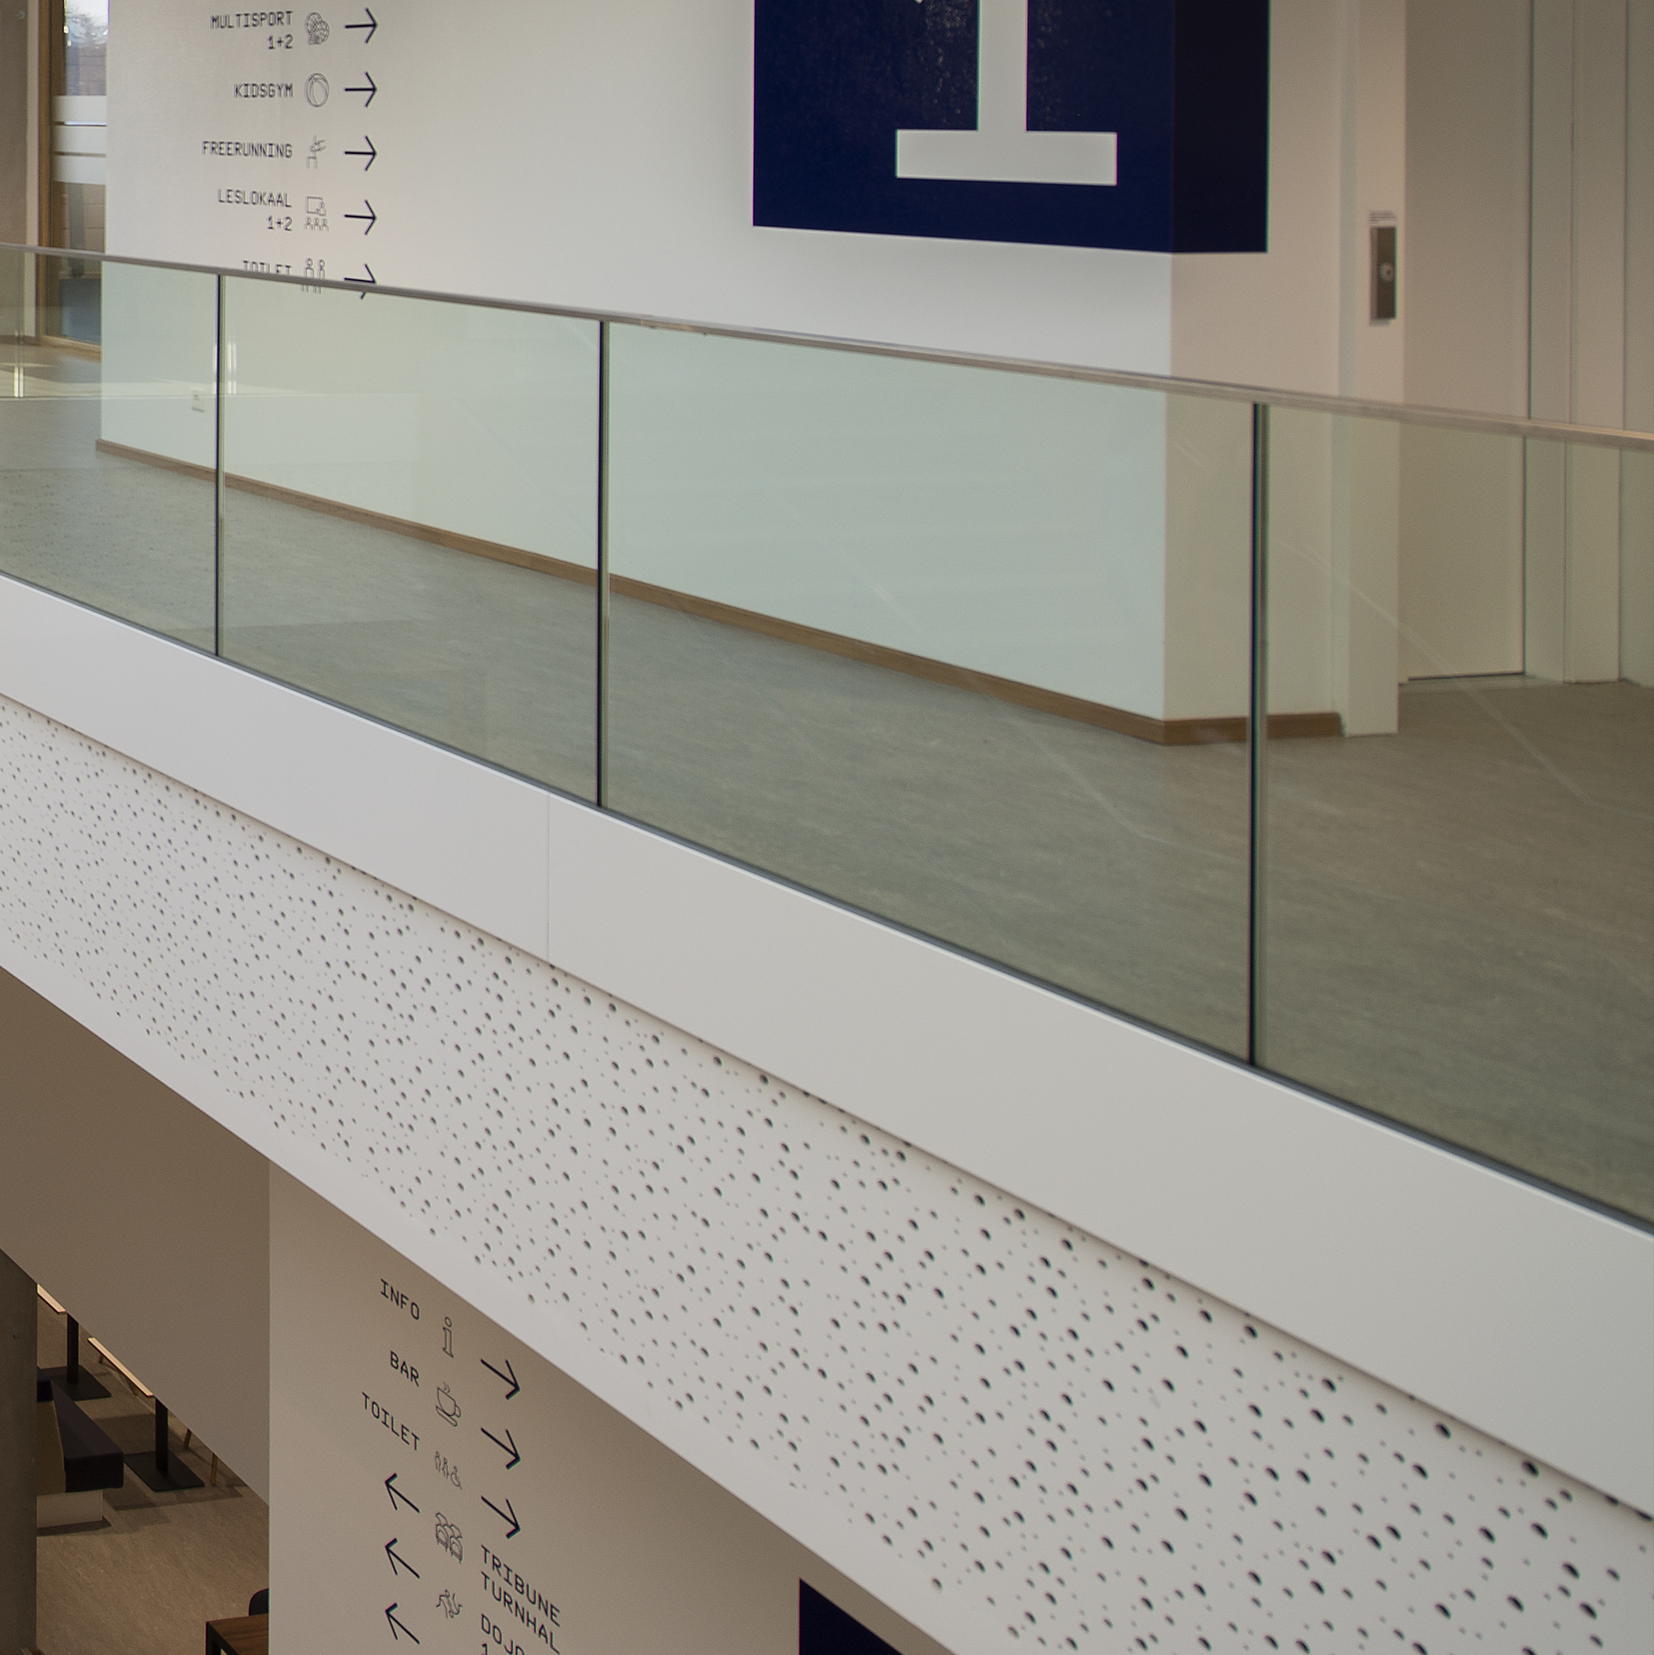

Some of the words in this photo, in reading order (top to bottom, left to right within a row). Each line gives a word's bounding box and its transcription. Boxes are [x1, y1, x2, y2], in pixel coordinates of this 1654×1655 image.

[210, 11, 293, 29] MULTISPORT
[267, 34, 293, 49] 1+2
[234, 82, 293, 98] KIDSGYM
[202, 140, 293, 158] FREERUNNING
[218, 189, 292, 208] LESLOKAAL
[267, 215, 293, 231] 1+2
[381, 1278, 420, 1321] INFO
[390, 1350, 419, 1387] BAR
[362, 1392, 420, 1451] TOILET
[481, 1544, 560, 1628] TRIBUNE
[481, 1571, 560, 1655] TURNHAL
